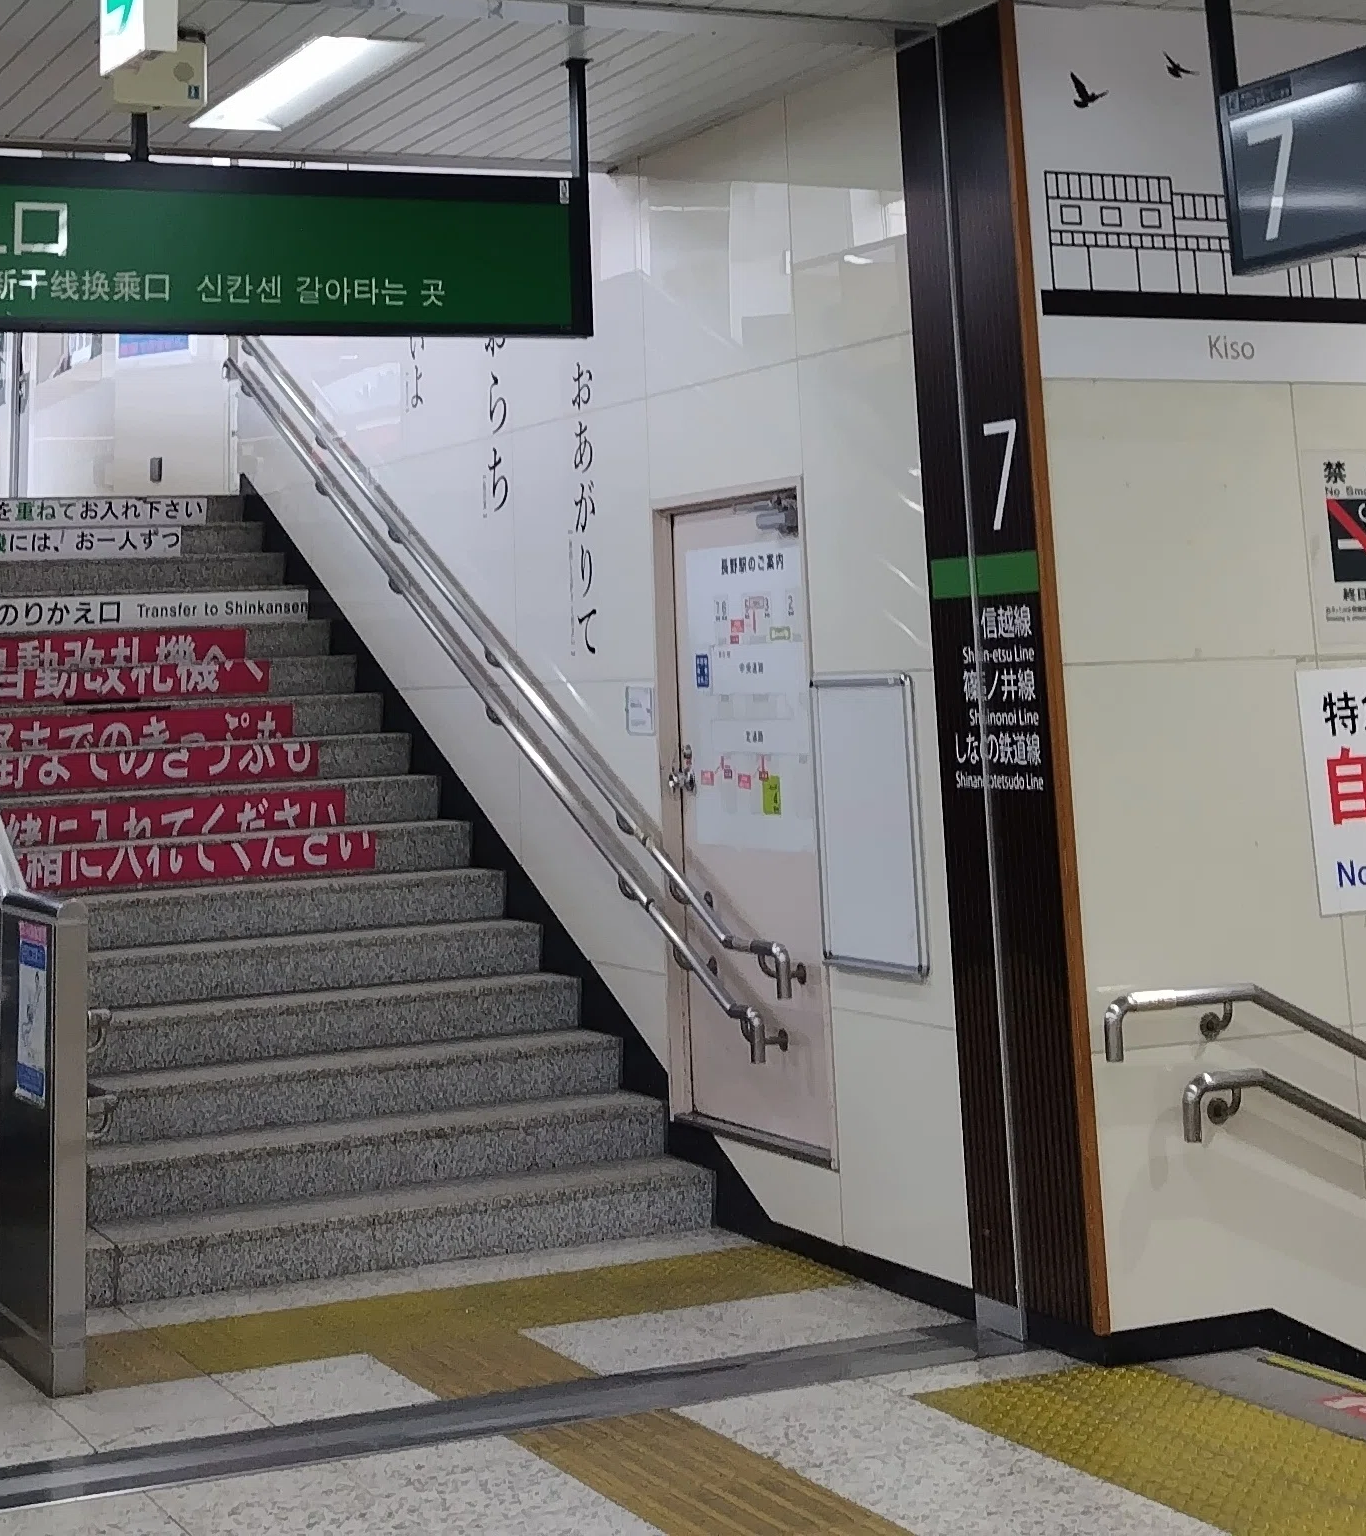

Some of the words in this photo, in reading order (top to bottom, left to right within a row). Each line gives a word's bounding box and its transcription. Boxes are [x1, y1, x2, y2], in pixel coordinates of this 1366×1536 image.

[1245, 117, 1295, 241] 7
[196, 274, 282, 306] 신칸센
[296, 275, 408, 306] 갈아타는
[420, 277, 446, 308] 곳
[1208, 335, 1255, 360] Kiso
[983, 418, 1016, 531] 7
[1325, 486, 1340, 498] No
[572, 362, 597, 654] おあがりて
[137, 602, 198, 618] Transfer
[204, 601, 218, 616] to
[225, 599, 309, 616] Shinkansen
[981, 604, 1032, 640] 信越線
[962, 645, 1013, 664] Shn-etsu
[1014, 644, 1035, 663] Line
[1018, 708, 1039, 726] Line
[955, 731, 1042, 766] しなの鉄道線
[1026, 772, 1044, 791] Line
